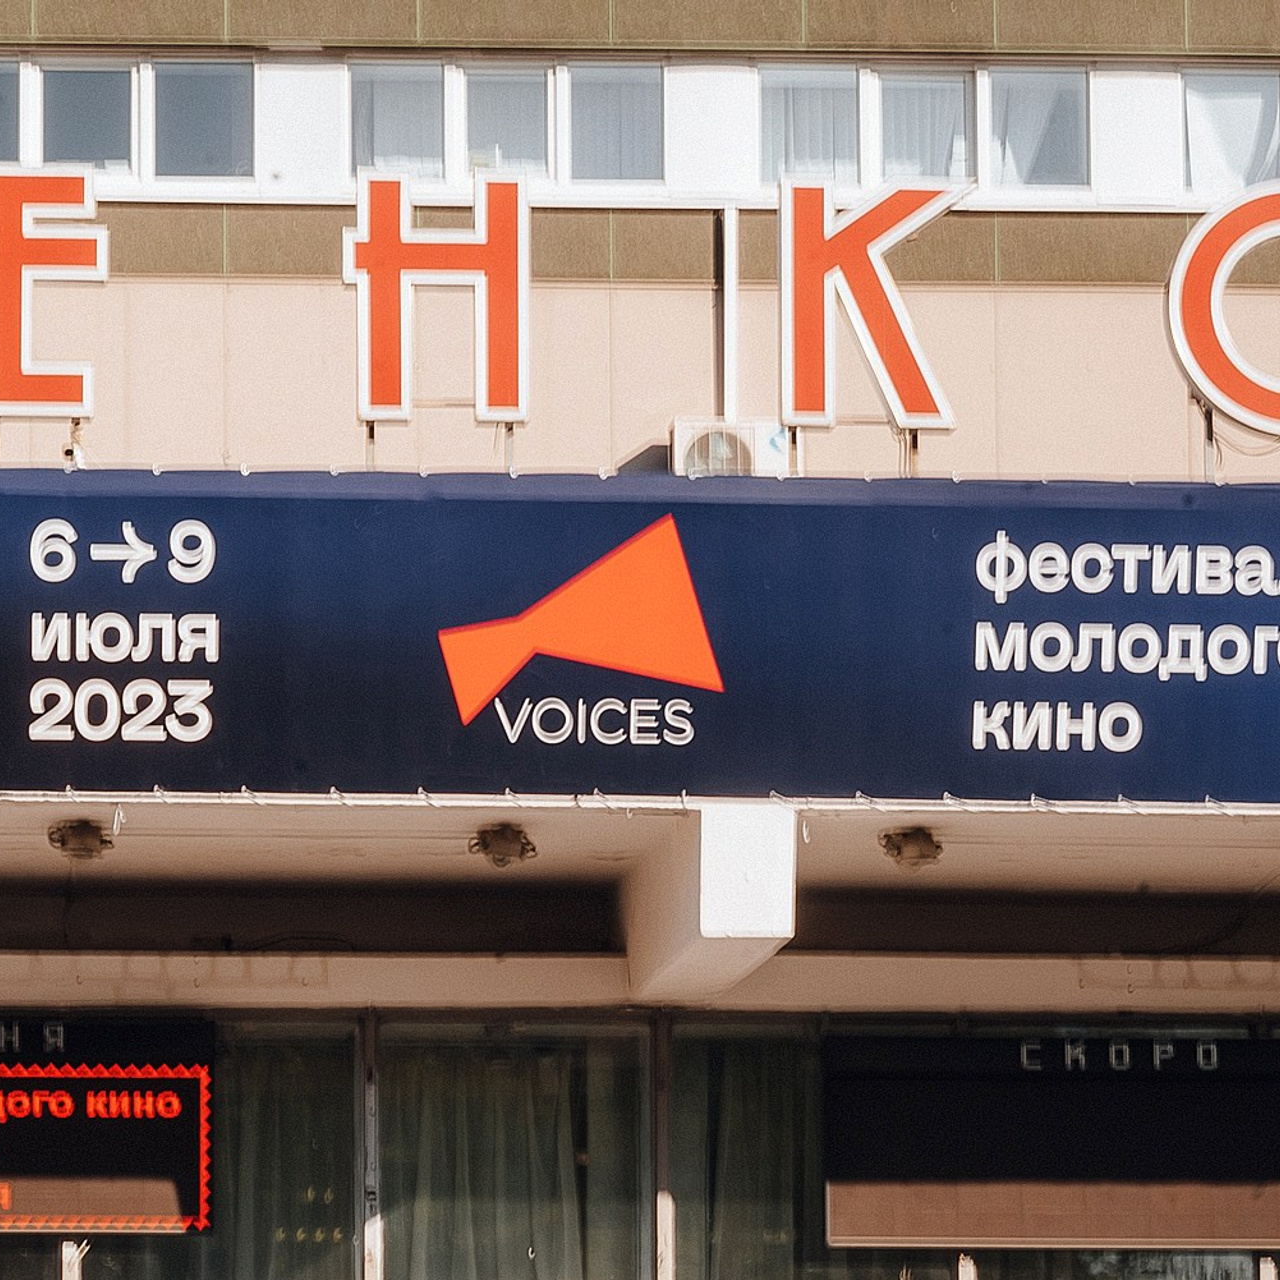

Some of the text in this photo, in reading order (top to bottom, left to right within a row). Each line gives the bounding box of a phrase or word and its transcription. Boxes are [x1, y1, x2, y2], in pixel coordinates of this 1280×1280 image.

[30, 518, 216, 583] 6 9
[976, 530, 1280, 604] фестива
[975, 621, 1280, 682] молодог
[29, 678, 213, 742] 2023
[494, 698, 695, 745] VOICES
[972, 700, 1143, 752] кино
[1021, 1039, 1219, 1071] СКОРО
[86, 1089, 182, 1118] кино
